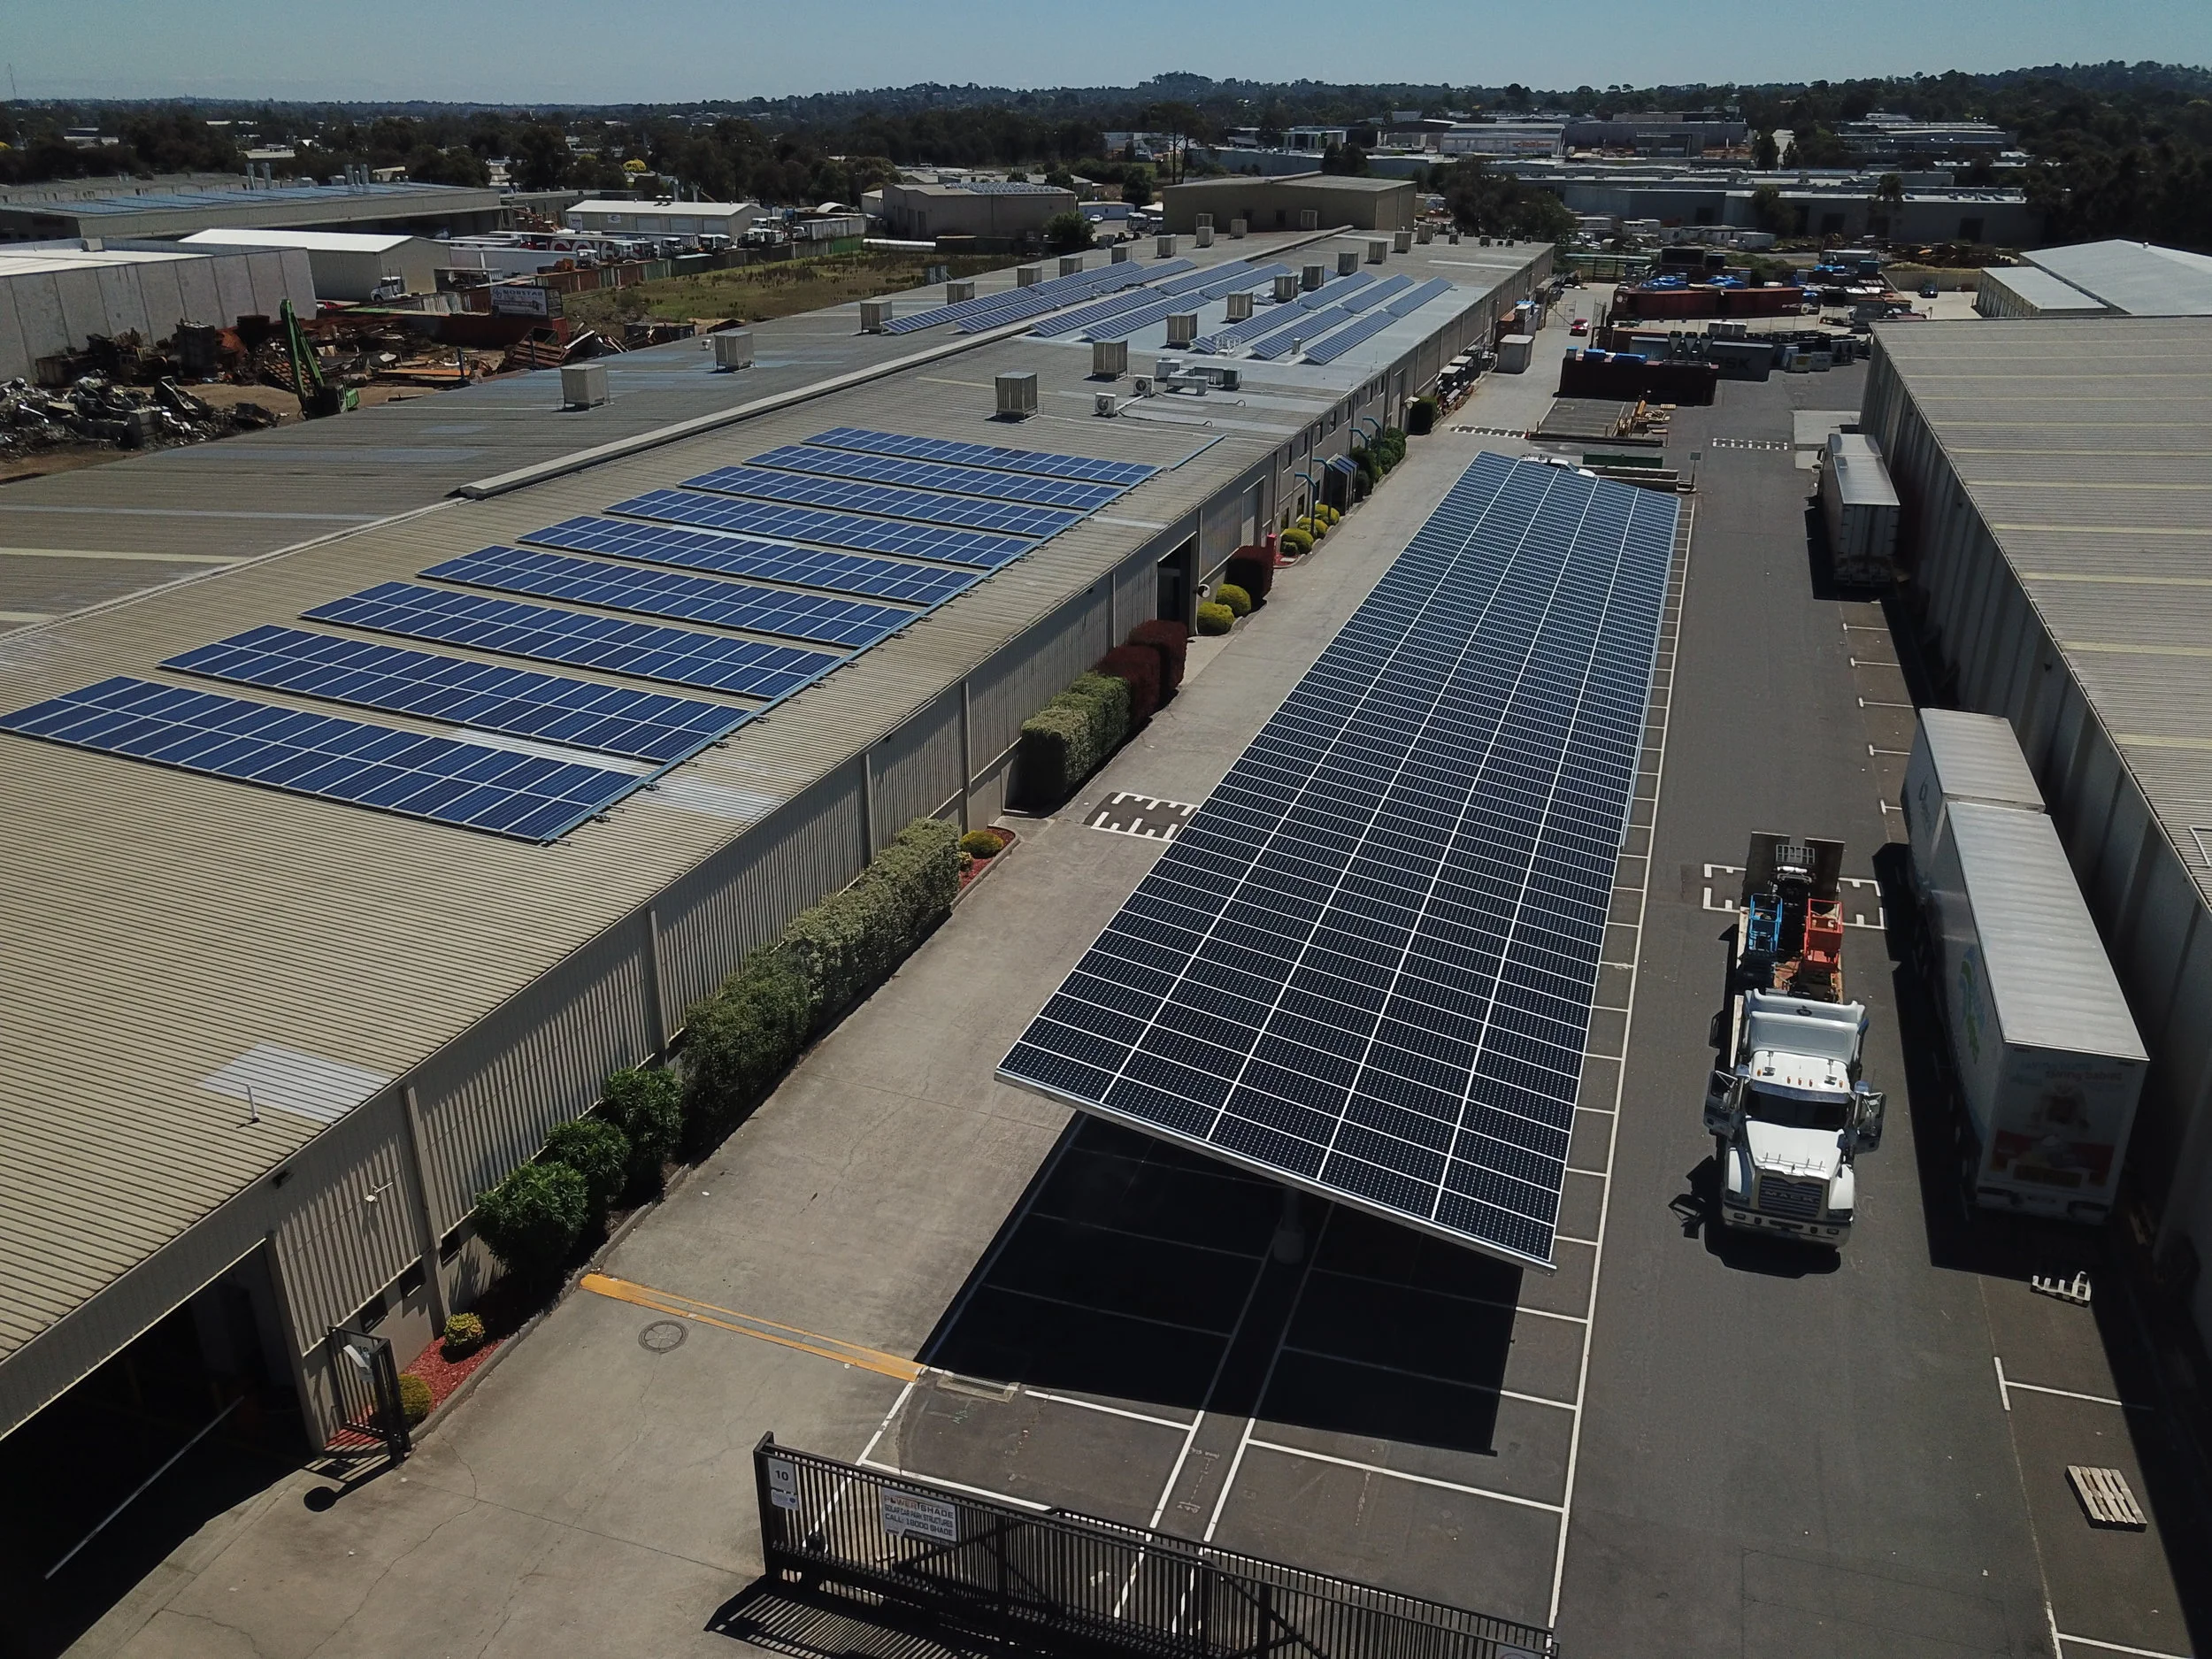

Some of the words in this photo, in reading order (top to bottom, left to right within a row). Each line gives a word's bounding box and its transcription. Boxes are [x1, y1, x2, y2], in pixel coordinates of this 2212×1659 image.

[775, 1470, 789, 1481] 10
[885, 1513, 905, 1524] CALL:
[930, 1524, 953, 1536] SHADE
[910, 1510, 923, 1520] PARK
[923, 1514, 953, 1528] STRUCTURES
